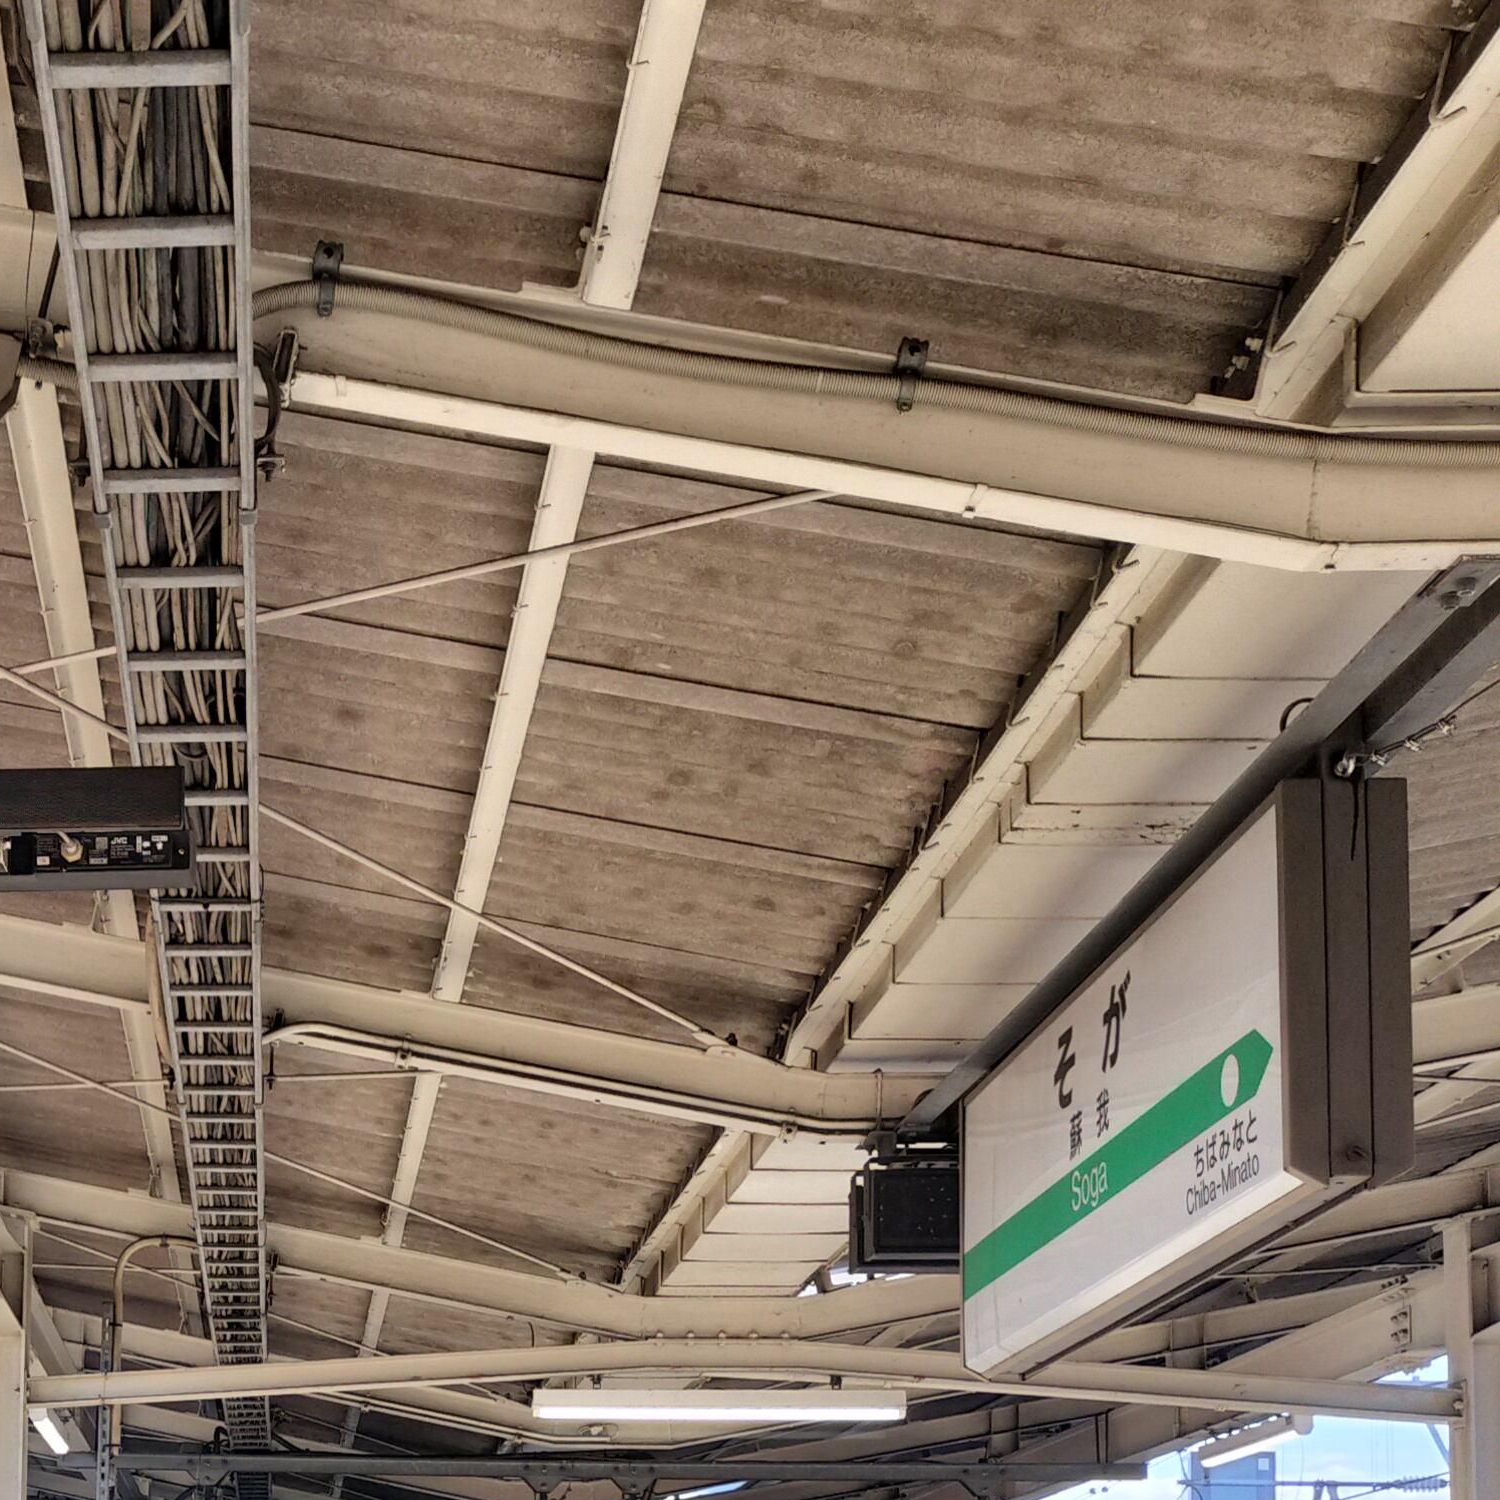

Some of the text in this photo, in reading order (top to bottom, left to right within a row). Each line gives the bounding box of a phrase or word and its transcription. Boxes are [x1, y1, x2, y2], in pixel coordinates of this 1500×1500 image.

[110, 836, 128, 845] JVC
[1054, 969, 1131, 1109] そが
[1069, 1088, 1110, 1161] 蘇我
[1193, 1110, 1258, 1178] ちばみなと
[1071, 1161, 1108, 1212] Soga
[1186, 1152, 1260, 1216] Chiba-Minato
